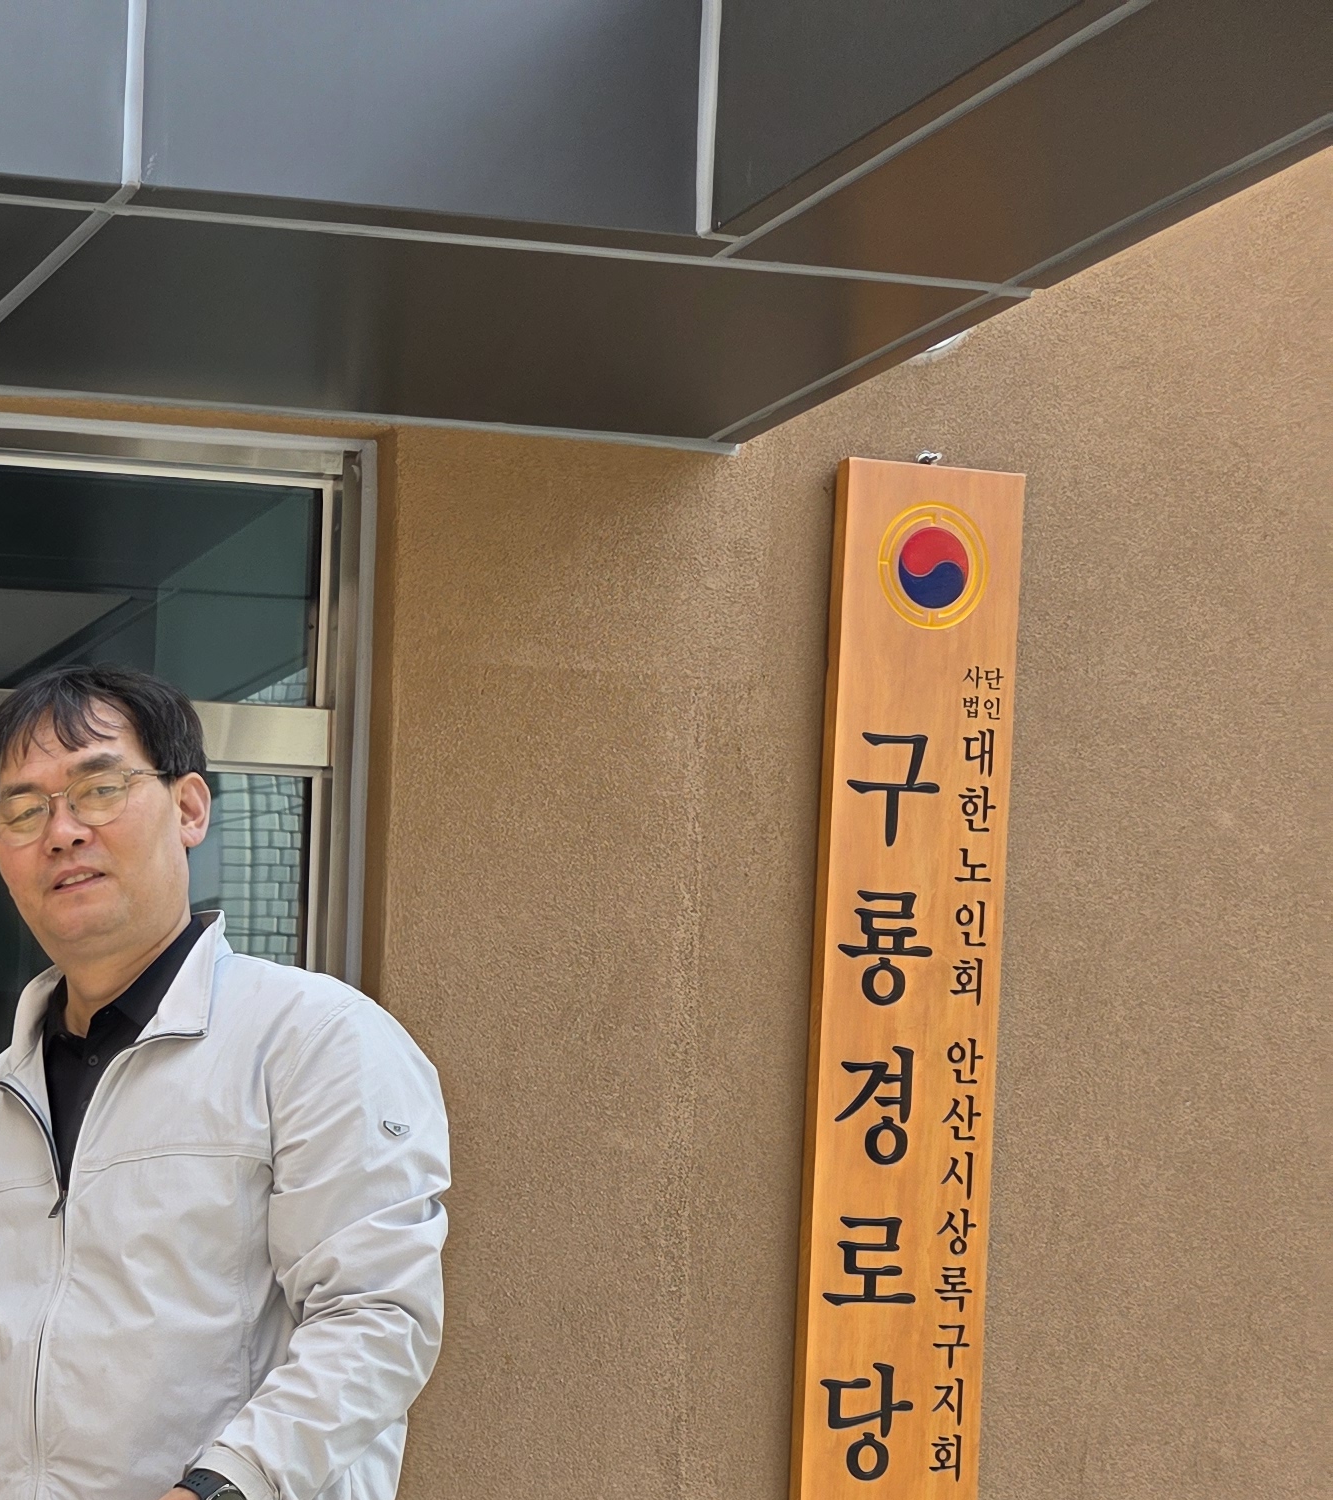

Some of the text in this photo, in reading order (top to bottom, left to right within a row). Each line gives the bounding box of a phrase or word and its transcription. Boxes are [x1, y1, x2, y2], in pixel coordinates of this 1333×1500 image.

[962, 665, 1004, 692] 사단
[962, 695, 1002, 721] 법인
[819, 731, 941, 1481] 구룡경로당
[928, 727, 998, 1483] 대한노인회 안산시상록구지회
